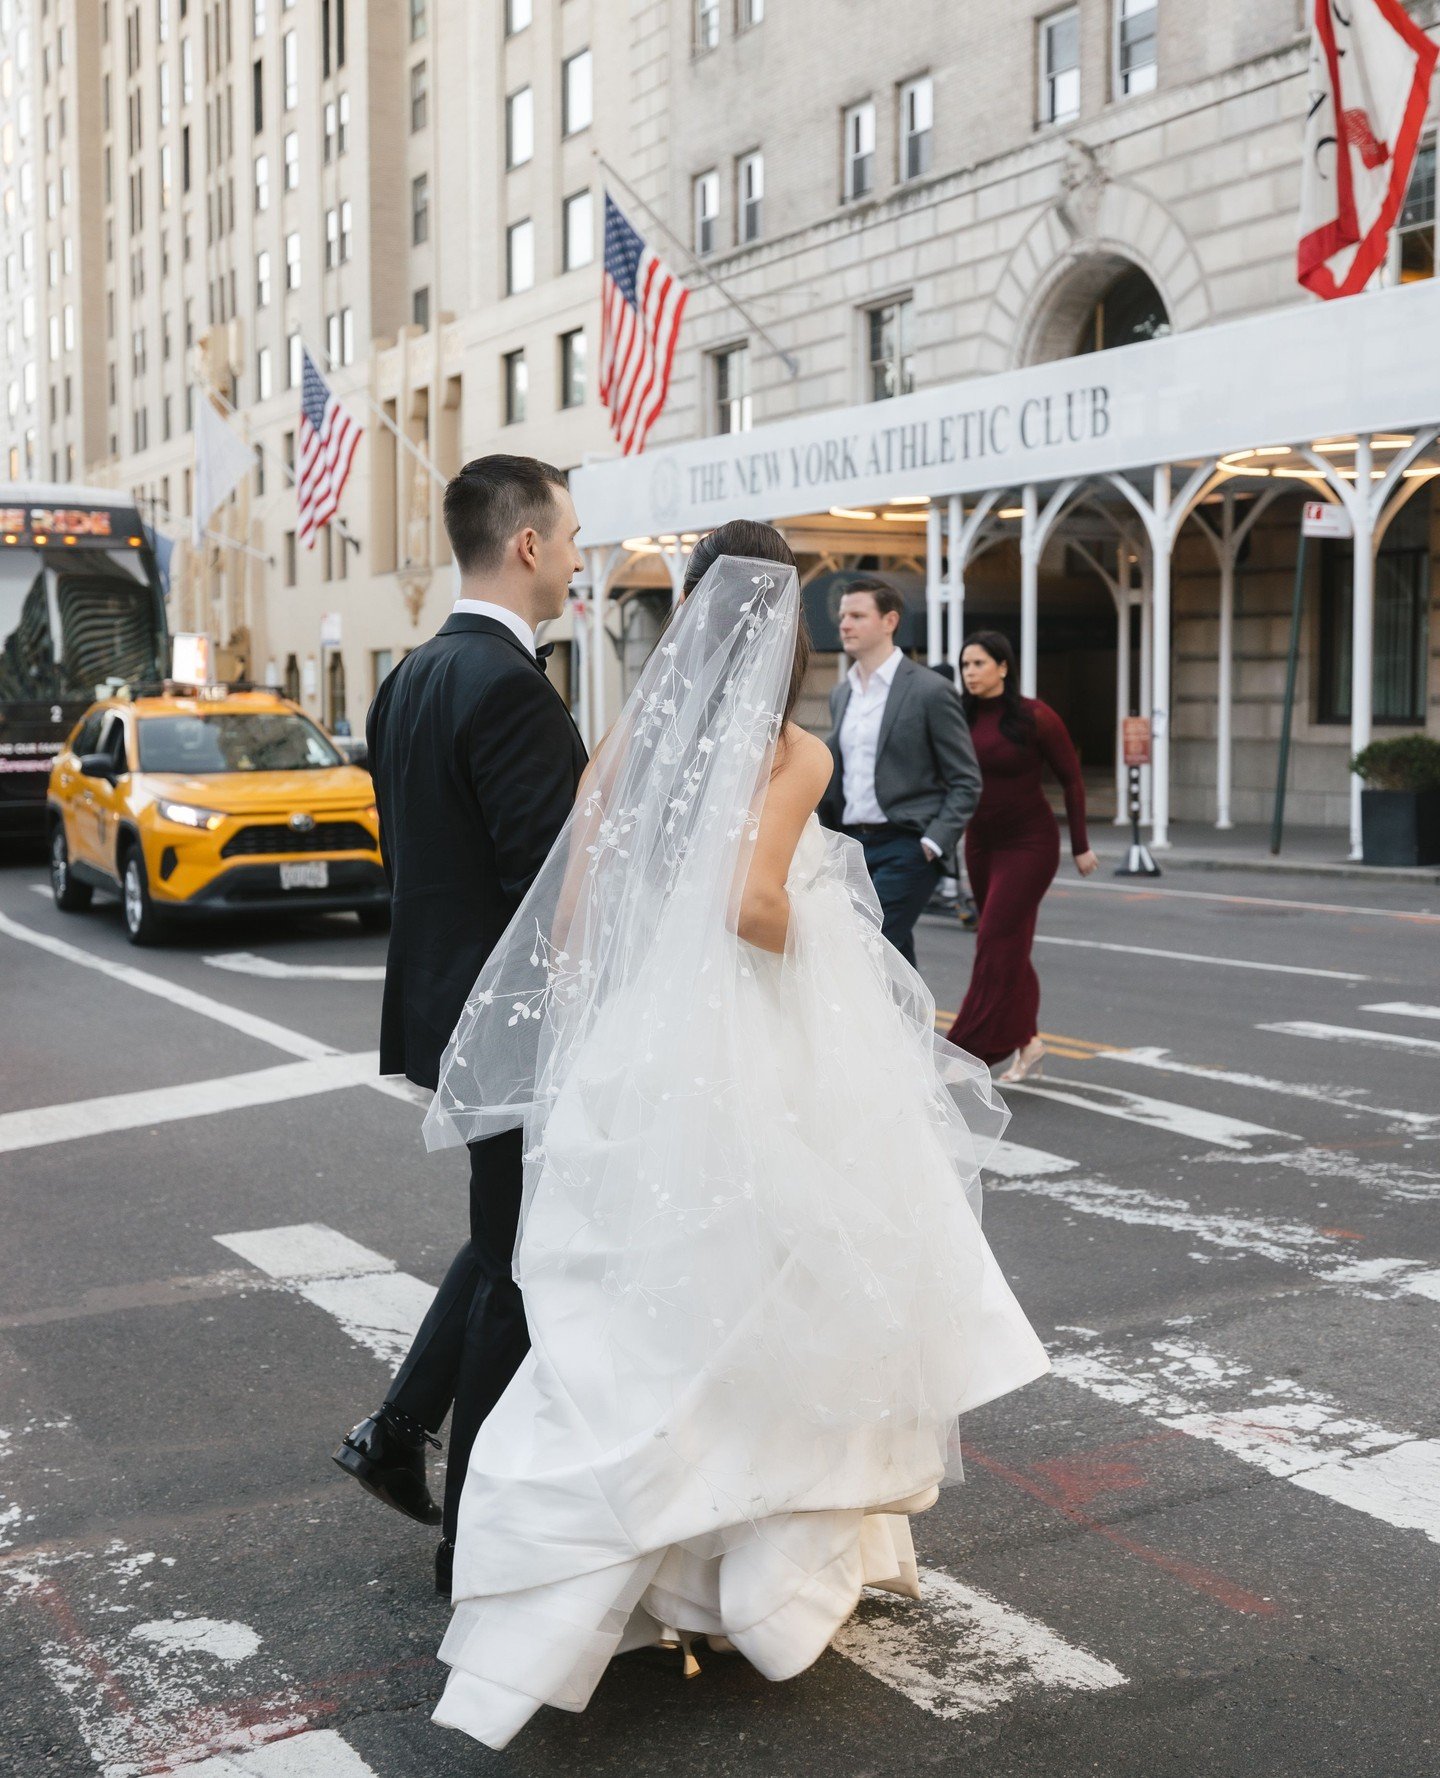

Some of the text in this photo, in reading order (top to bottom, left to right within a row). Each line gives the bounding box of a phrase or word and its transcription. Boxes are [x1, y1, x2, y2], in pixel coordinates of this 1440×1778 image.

[689, 384, 1111, 505] THE NEW YORK ATHLETIC CLUB
